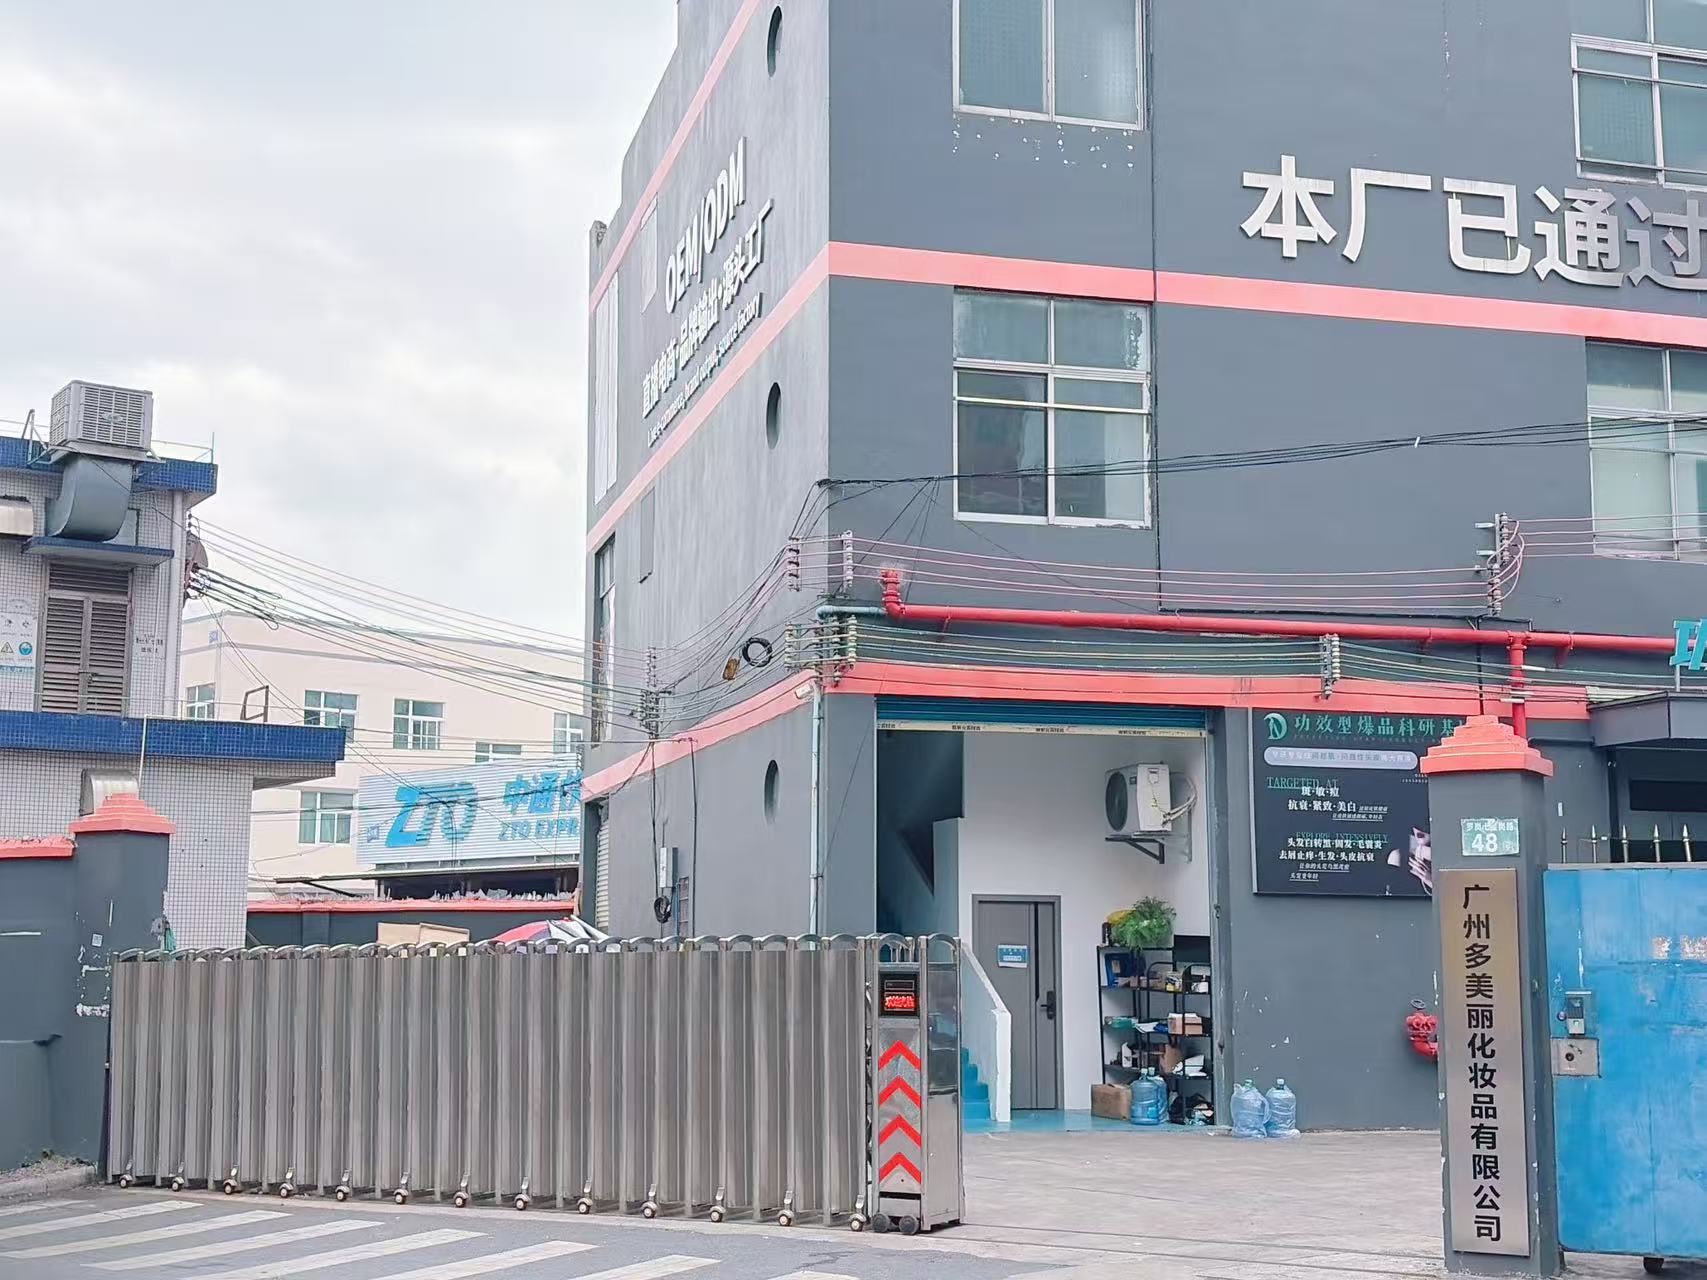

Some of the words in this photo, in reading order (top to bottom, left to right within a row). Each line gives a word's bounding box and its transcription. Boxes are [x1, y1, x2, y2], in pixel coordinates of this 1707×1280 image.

[1240, 154, 1707, 291] 本厂已通过
[1294, 714, 1461, 738] 功效型爆品科研基
[1267, 777, 1319, 789] TARGETED
[1462, 883, 1502, 1242] 广州多美丽化妆品有限公司
